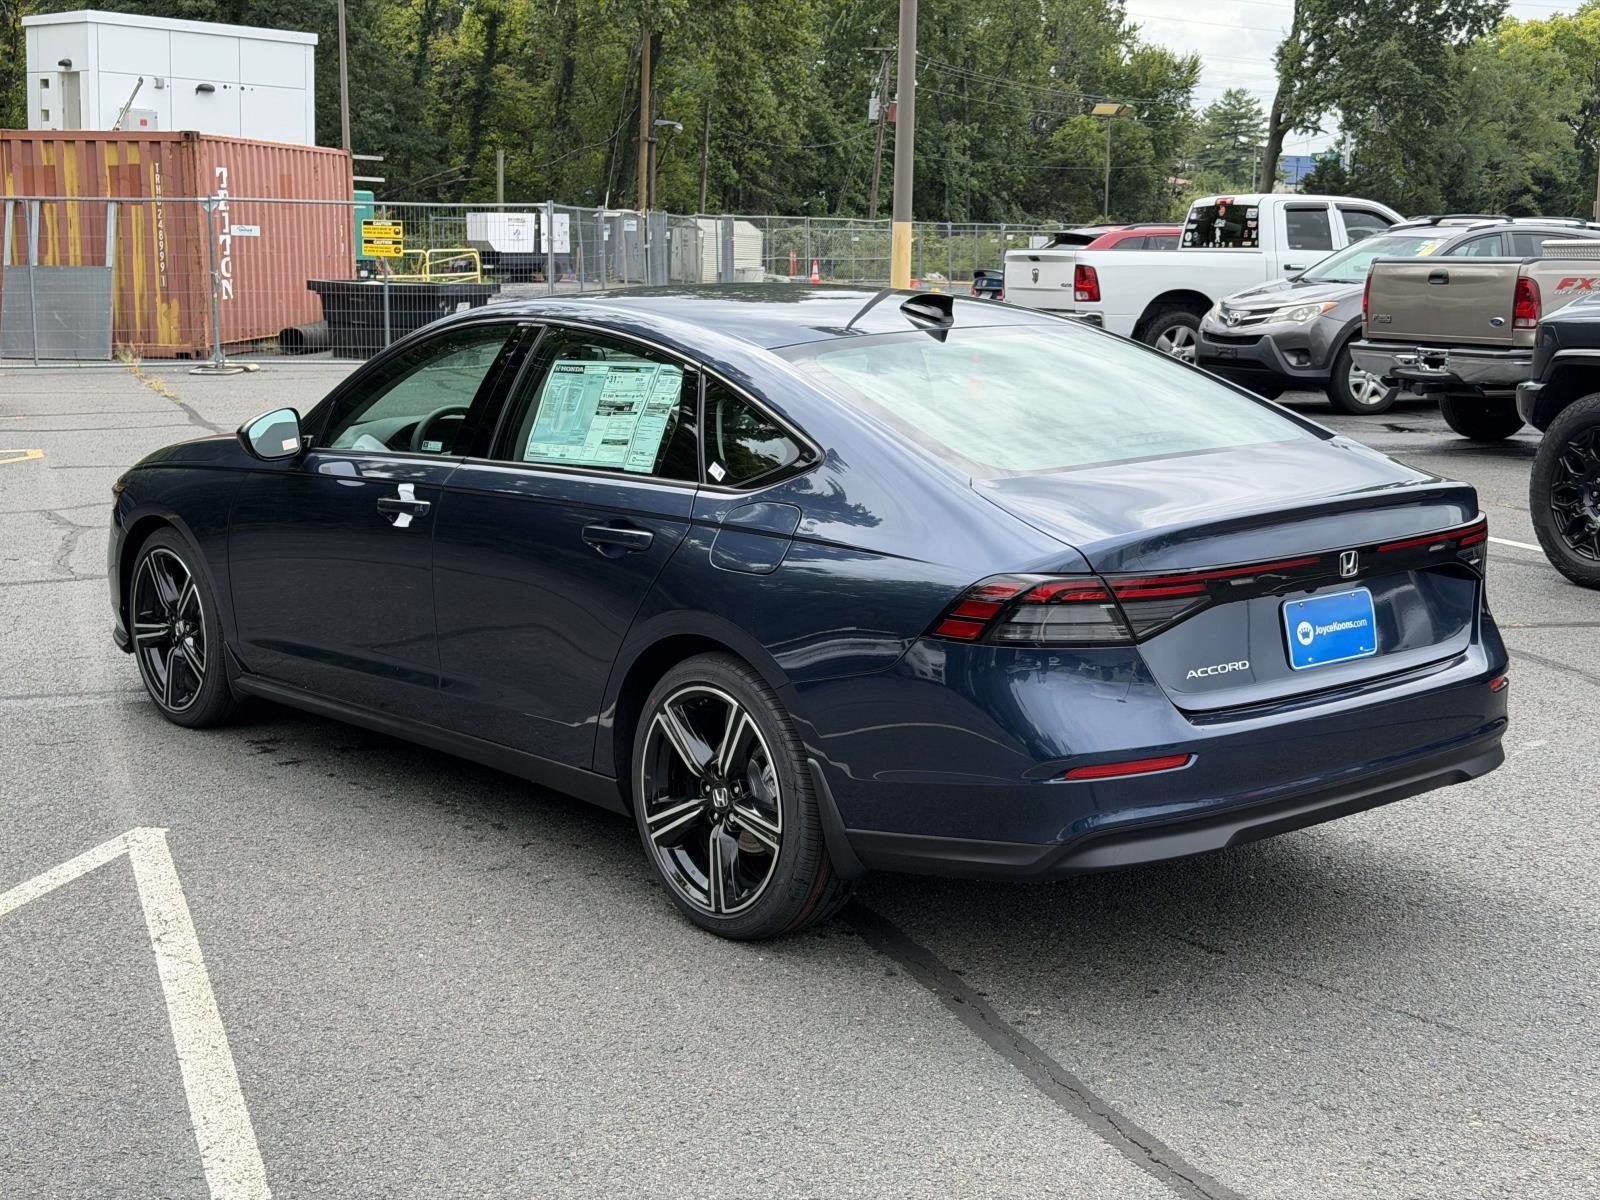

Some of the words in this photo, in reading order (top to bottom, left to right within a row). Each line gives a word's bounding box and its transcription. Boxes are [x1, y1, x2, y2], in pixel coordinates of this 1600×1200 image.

[560, 365, 584, 373] HONDA
[1314, 618, 1368, 636] JoyceKoons.com
[1185, 659, 1250, 680] ACCORD
